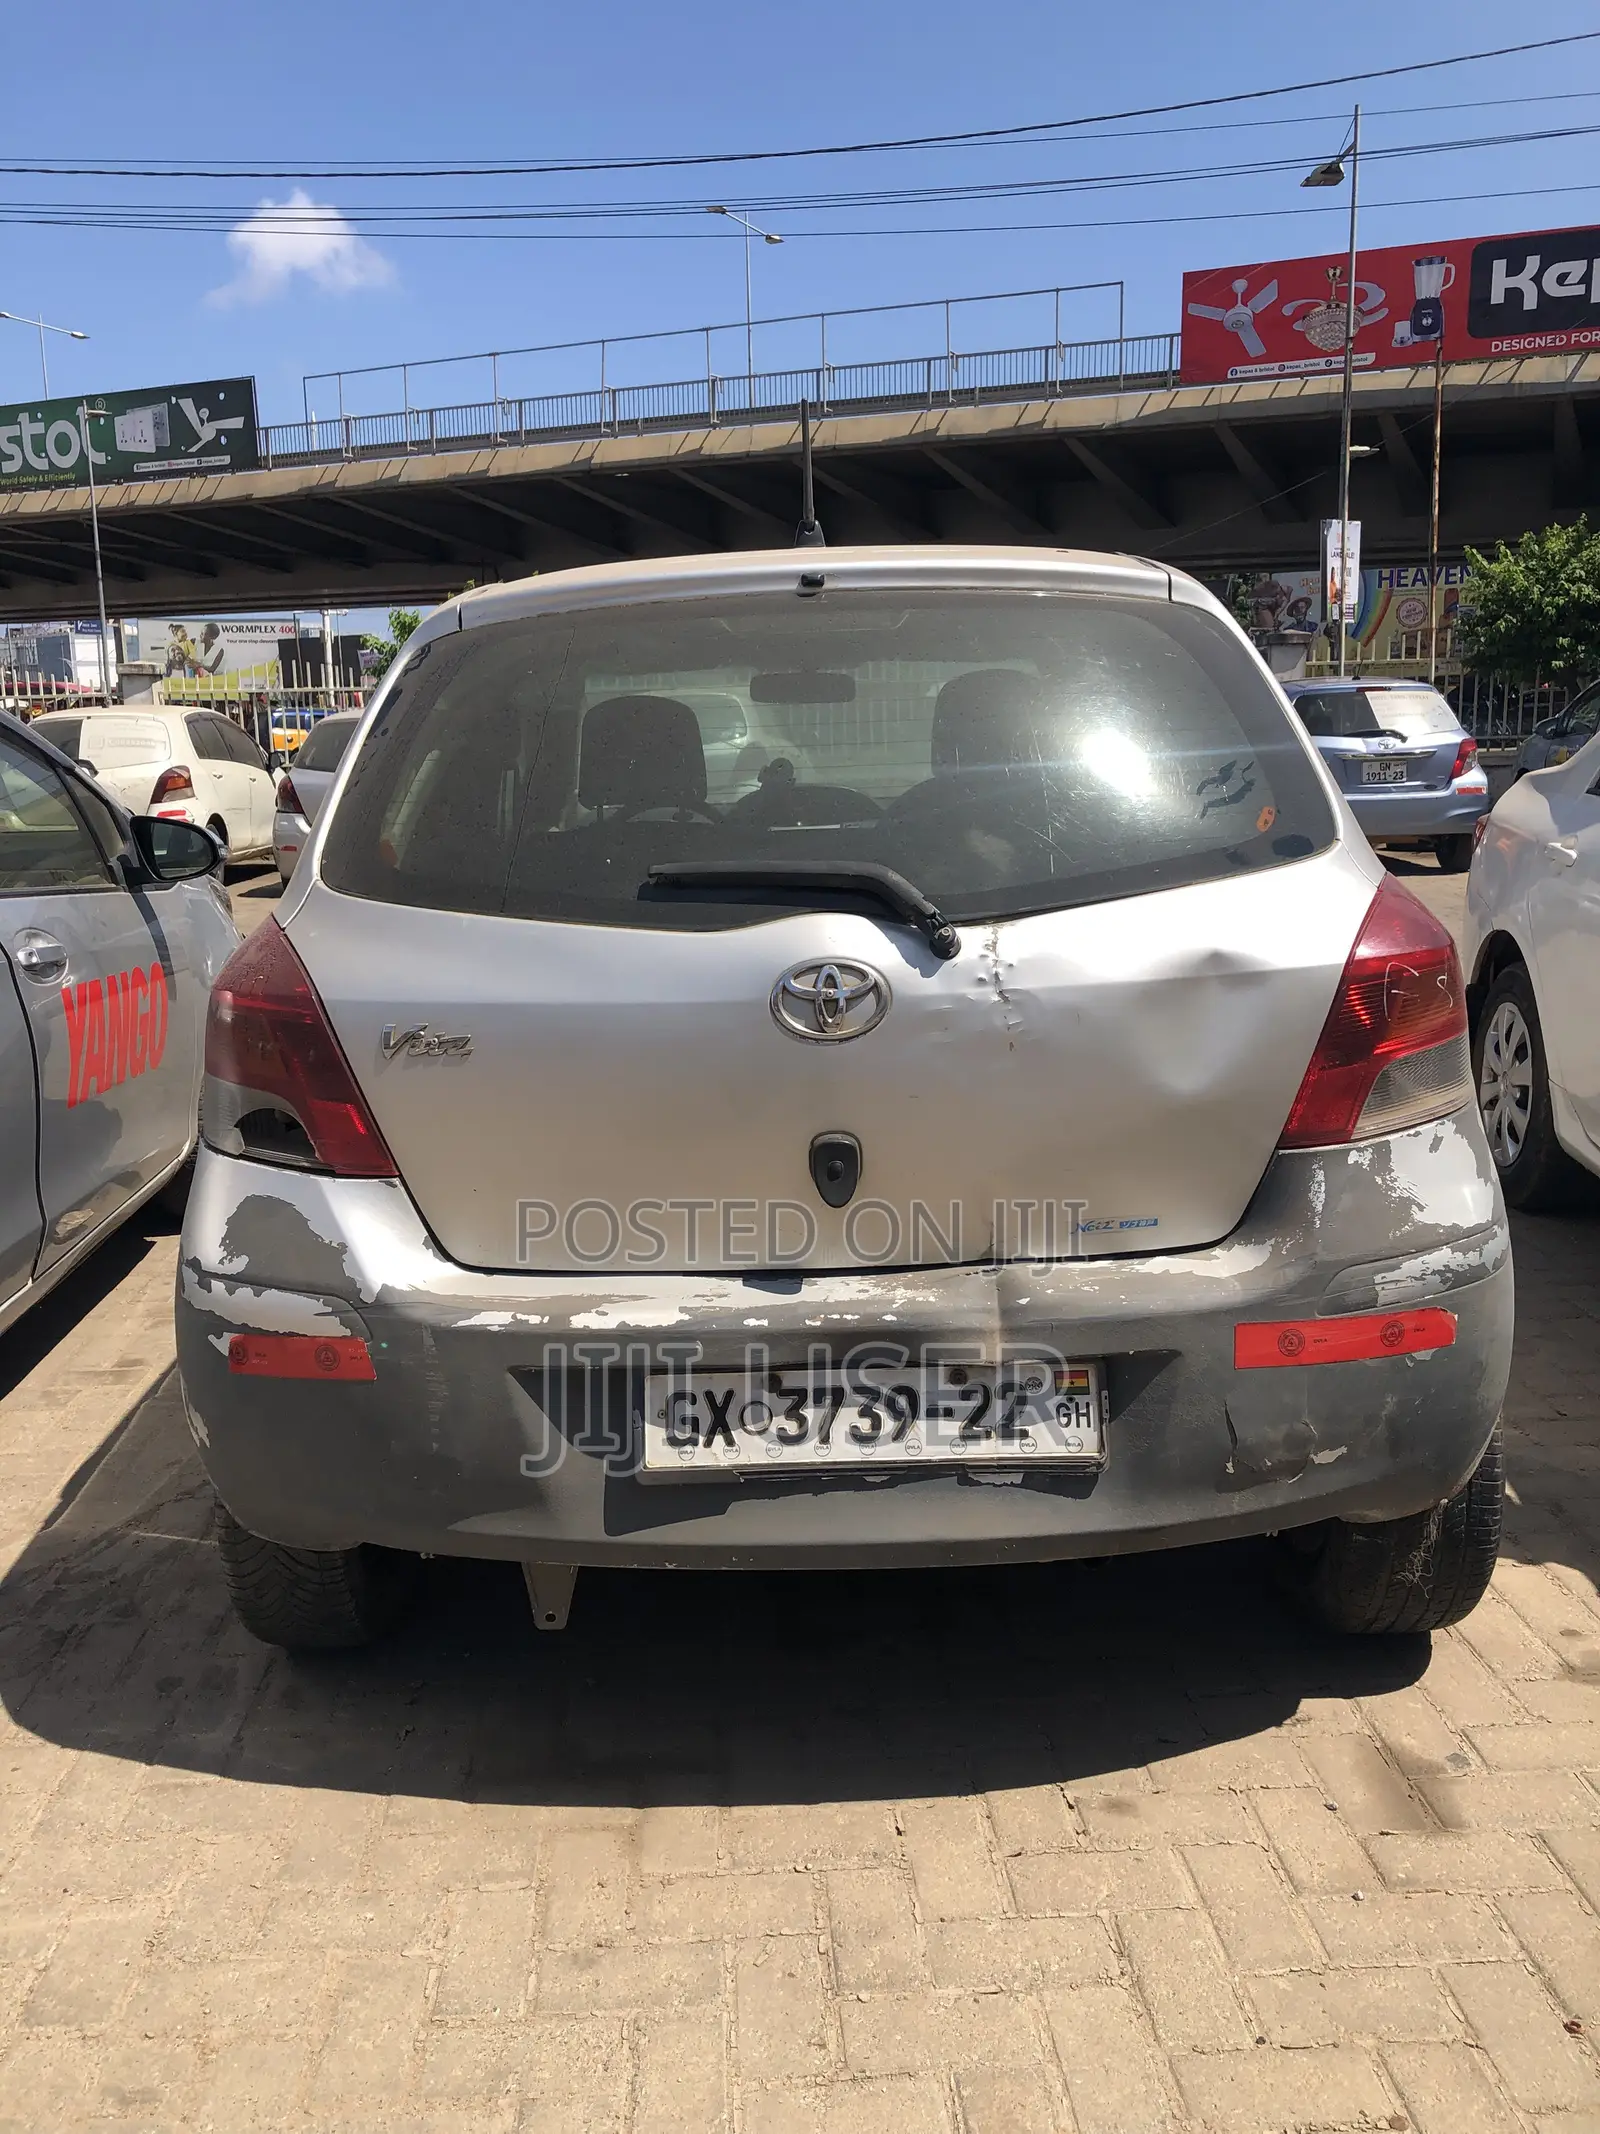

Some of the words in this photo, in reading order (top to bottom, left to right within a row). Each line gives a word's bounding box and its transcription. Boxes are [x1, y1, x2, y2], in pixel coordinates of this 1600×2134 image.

[1491, 254, 1600, 310] Ke
[1491, 334, 1567, 352] DESIGNED
[1571, 331, 1600, 345] FOR
[19, 475, 38, 484] Safely
[221, 625, 276, 634] WORMPLEX
[279, 625, 296, 634] 400
[1366, 770, 1404, 781] 1911-23
[1380, 762, 1391, 771] GN
[61, 962, 168, 1110] YANGO
[382, 1022, 475, 1060] Vitz
[665, 1388, 737, 1448] GX
[776, 1381, 1031, 1447] 3739-22
[1055, 1401, 1092, 1429] GH
